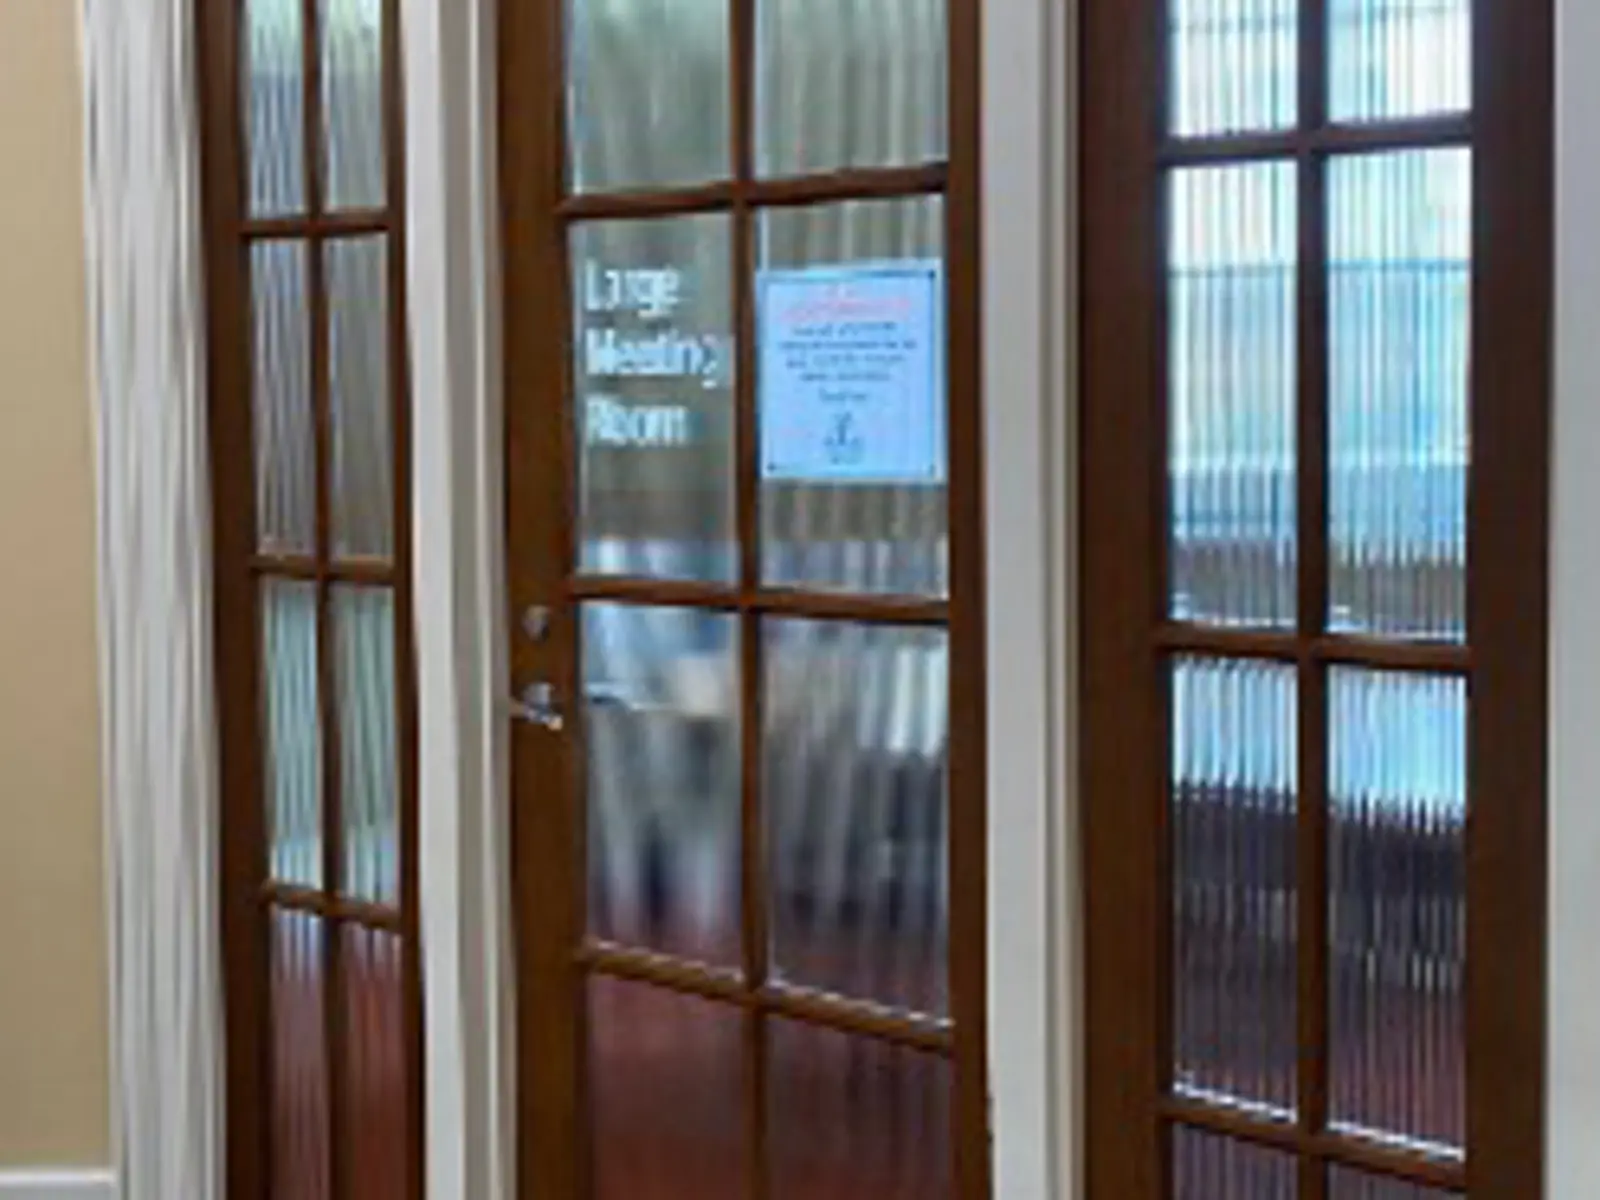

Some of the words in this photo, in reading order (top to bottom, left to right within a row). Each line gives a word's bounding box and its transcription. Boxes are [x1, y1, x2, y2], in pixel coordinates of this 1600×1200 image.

[585, 259, 681, 318] Large
[585, 328, 720, 388] Meeting
[585, 395, 688, 446] Room
